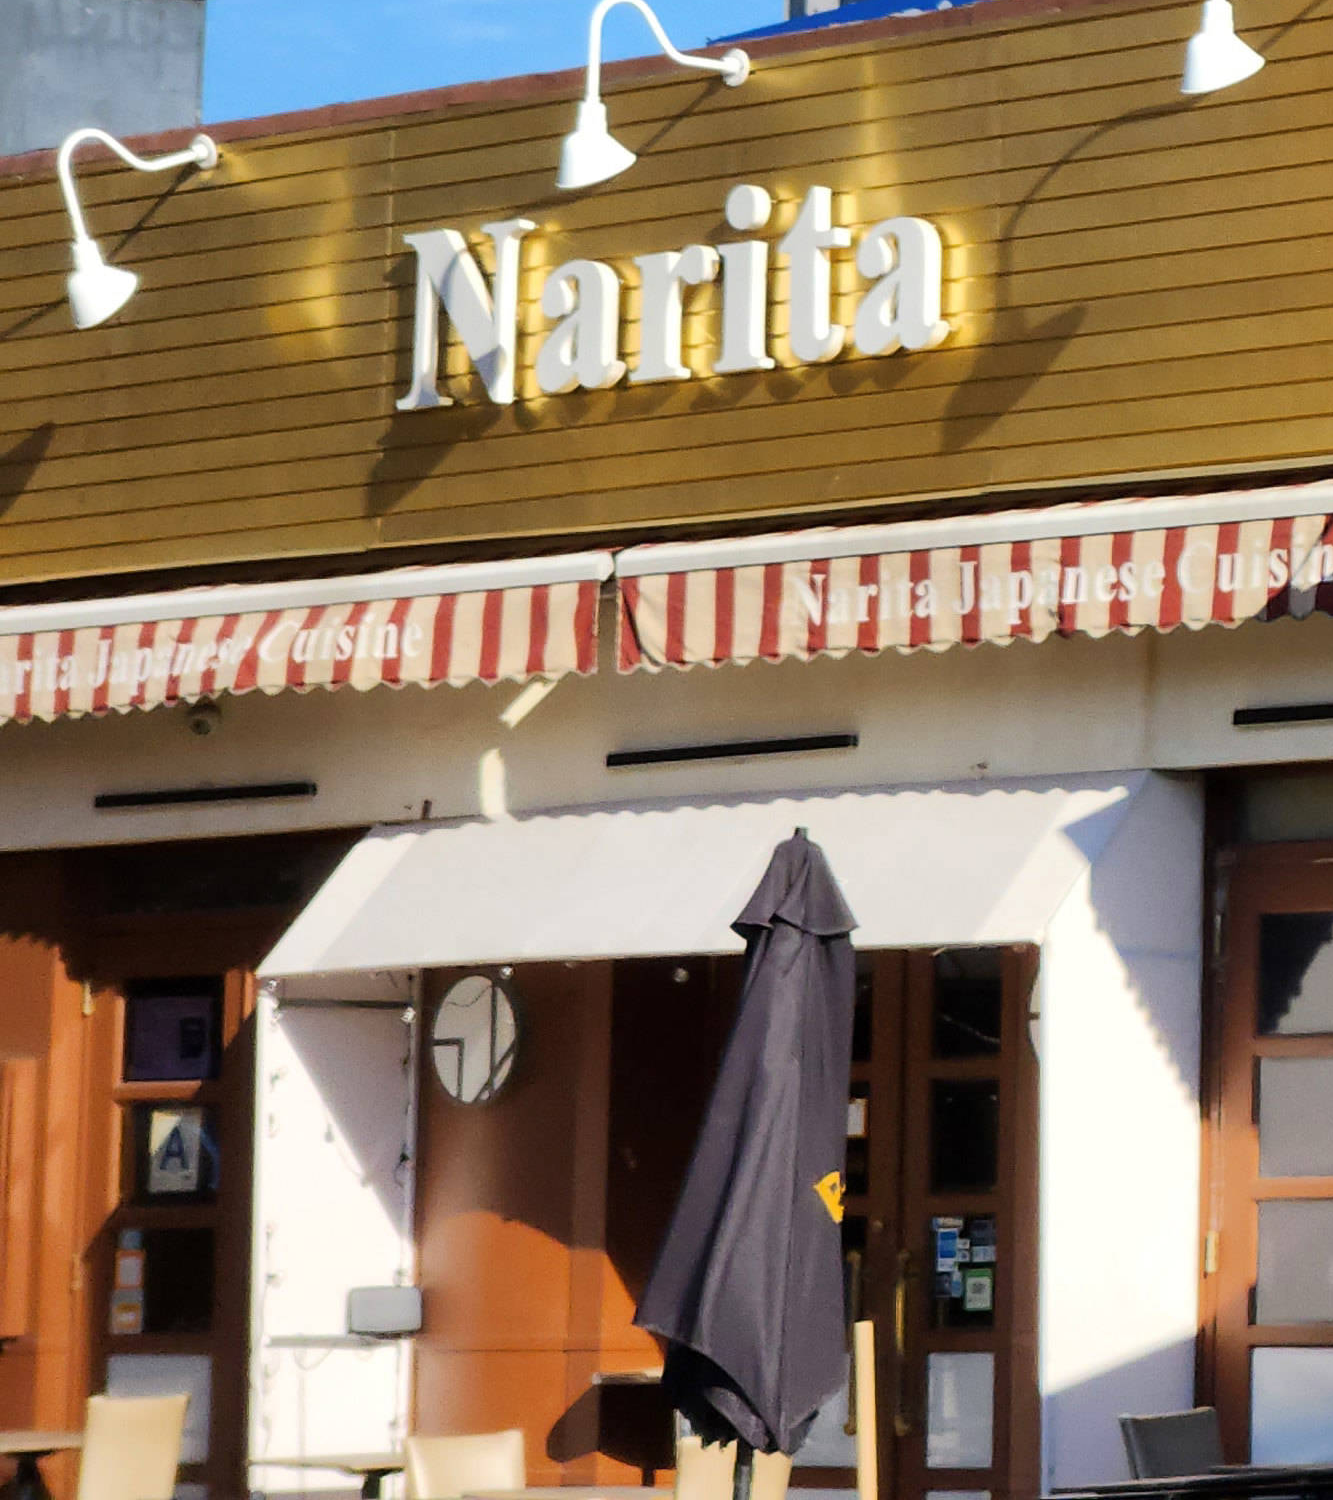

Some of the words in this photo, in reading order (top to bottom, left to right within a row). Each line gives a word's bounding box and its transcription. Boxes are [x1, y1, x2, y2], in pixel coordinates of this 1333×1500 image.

[396, 183, 951, 410] Narita
[794, 573, 937, 627] Narita
[952, 558, 1166, 626] Japanese
[88, 634, 252, 696] Japanese
[259, 613, 424, 664] Cuisine
[159, 1126, 190, 1171] A
